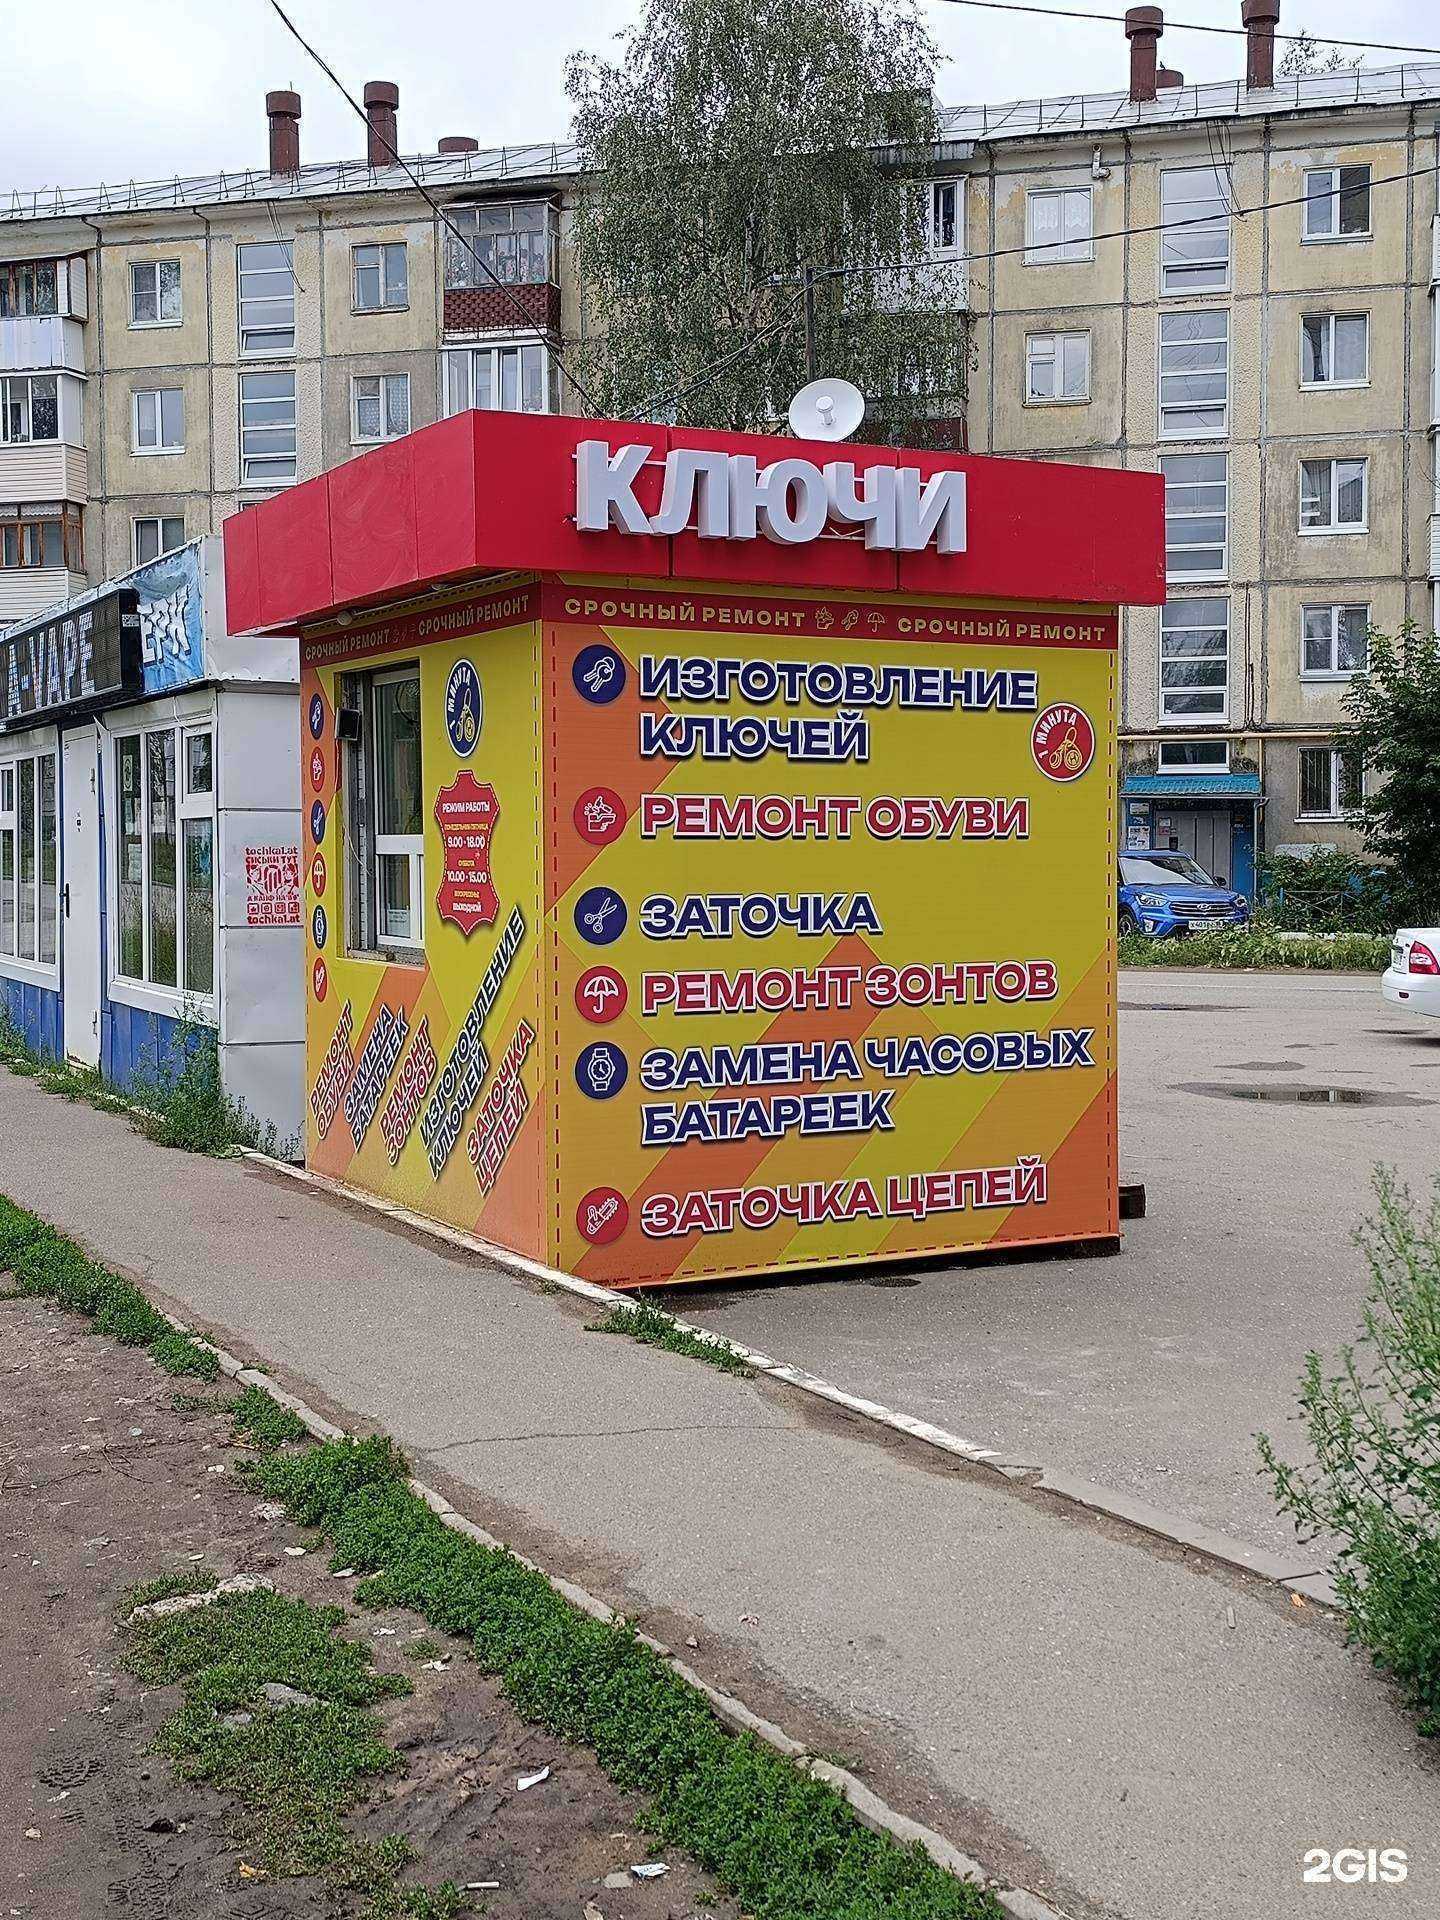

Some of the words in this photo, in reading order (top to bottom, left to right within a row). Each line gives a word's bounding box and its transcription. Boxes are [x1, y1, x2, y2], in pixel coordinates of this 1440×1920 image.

[576, 439, 968, 555] КЛЮЧИ
[418, 606, 474, 636] СРОЧНЫЙ
[476, 595, 529, 624] РЕМОНТ
[564, 598, 696, 622] СРОЧНЫЙ
[702, 607, 806, 628] РЕМОНТ
[897, 617, 1011, 638] СРОЧНЫЙ
[1016, 624, 1107, 642] РЕМОНТ
[305, 636, 349, 661] СРОЧНЫЙ
[350, 628, 390, 652] РЕМОНТ
[447, 666, 472, 713] МИНУТА
[639, 654, 1038, 710] ИЗГОТОВЛЕНИЕ
[639, 710, 870, 761] КЛЮЧЕЙ
[1035, 709, 1077, 745] МИНУТА
[641, 793, 864, 840] РЕМОНТ
[865, 796, 1030, 839] ОБУВИ
[640, 892, 883, 939] ЗАТОЧКА
[641, 965, 865, 1015] РЕМОНТ
[865, 960, 1059, 1006] ЗОНТОВ
[417, 904, 527, 1150] ИЗГОТОВЛЕНИЕ
[310, 998, 354, 1119] РЕМОНТ
[344, 1002, 394, 1123] ЗАМЕНА
[351, 1006, 410, 1153] БАТАРЕЕК
[378, 1014, 430, 1142] РЕМОНТ
[640, 1039, 864, 1090] ЗАМЕНА
[863, 1028, 1097, 1077] ЧАСОВЫХ
[317, 1042, 355, 1140] ОБУВИ
[387, 1046, 438, 1167] ЗОНТОВ
[428, 1038, 490, 1182] КЛЮЧЕЙ
[466, 1017, 535, 1165] ЗАТОЧКА
[641, 1089, 896, 1147] БАТАРЕЕК
[474, 1077, 528, 1197] ЦЕПЕЙ
[641, 1178, 882, 1238] ЗАТОЧКА
[885, 1153, 1049, 1220] ЦЕПЕЙ
